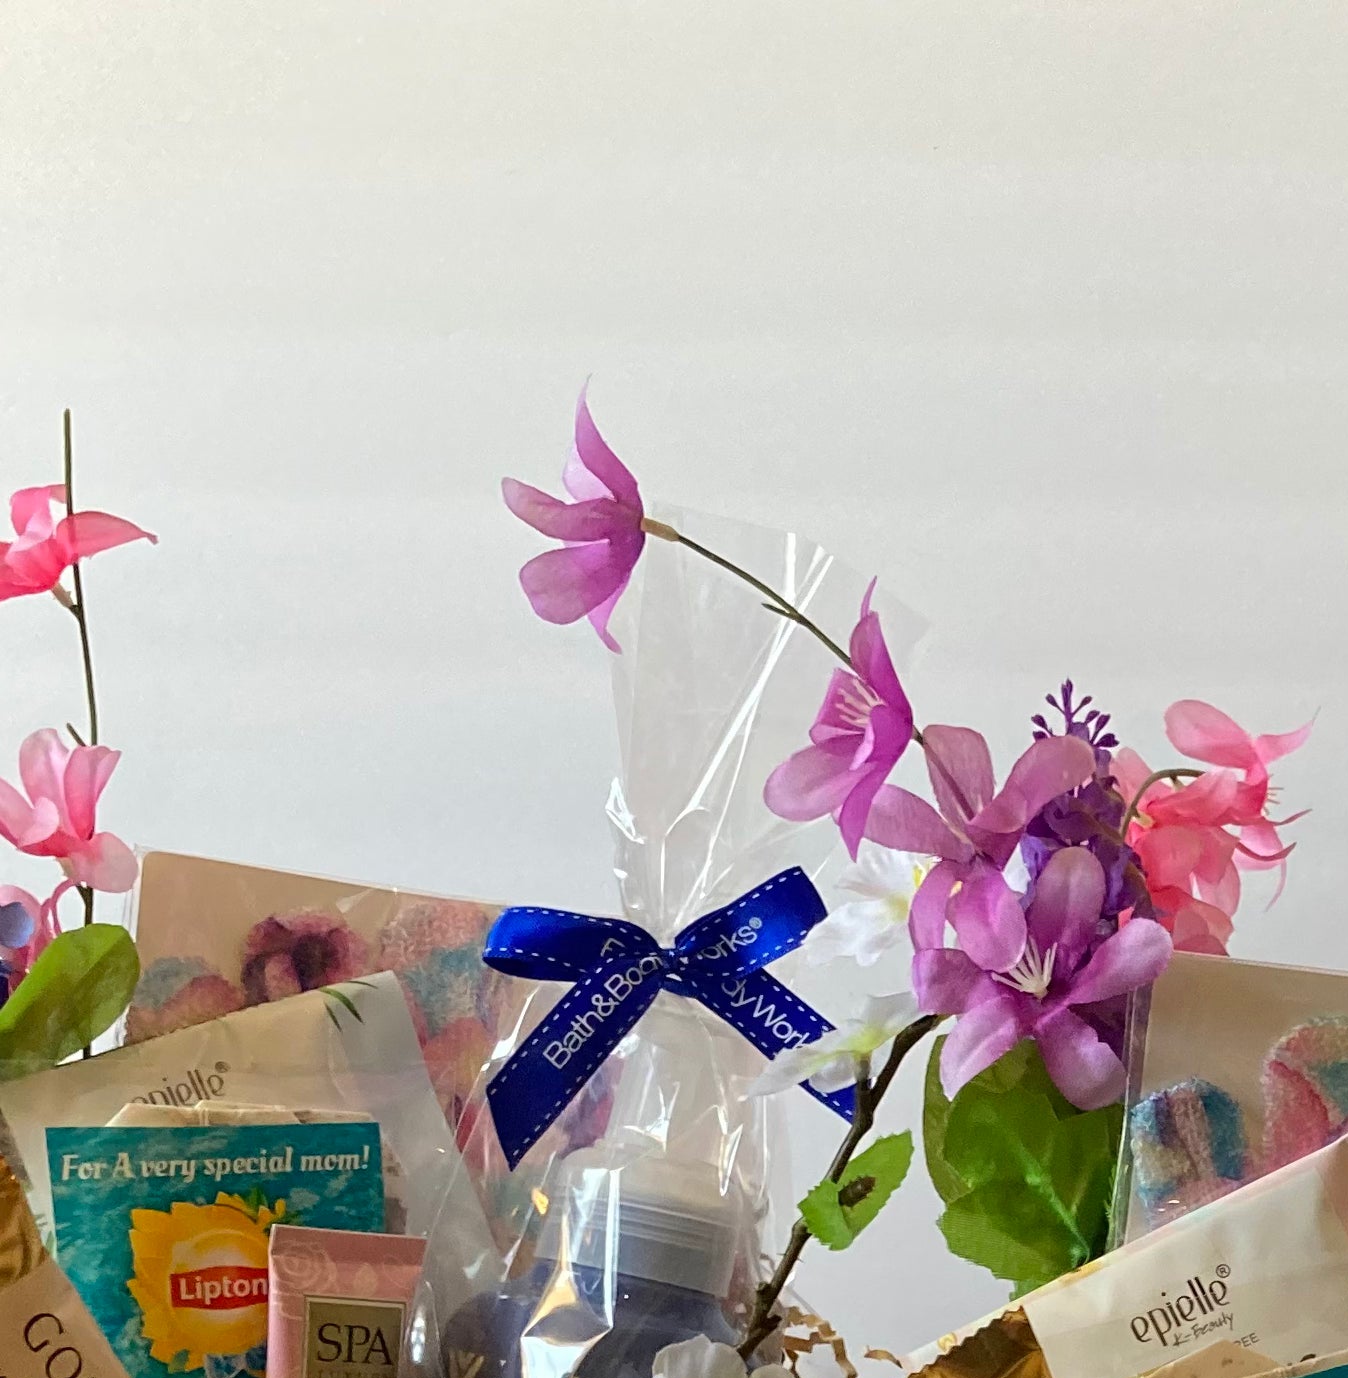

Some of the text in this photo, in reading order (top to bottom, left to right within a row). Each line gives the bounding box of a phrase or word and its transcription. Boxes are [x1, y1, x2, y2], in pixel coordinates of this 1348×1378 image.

[62, 1145, 370, 1183] For A very special mom!
[180, 1275, 268, 1305] Lipton
[317, 1322, 394, 1366] SPA
